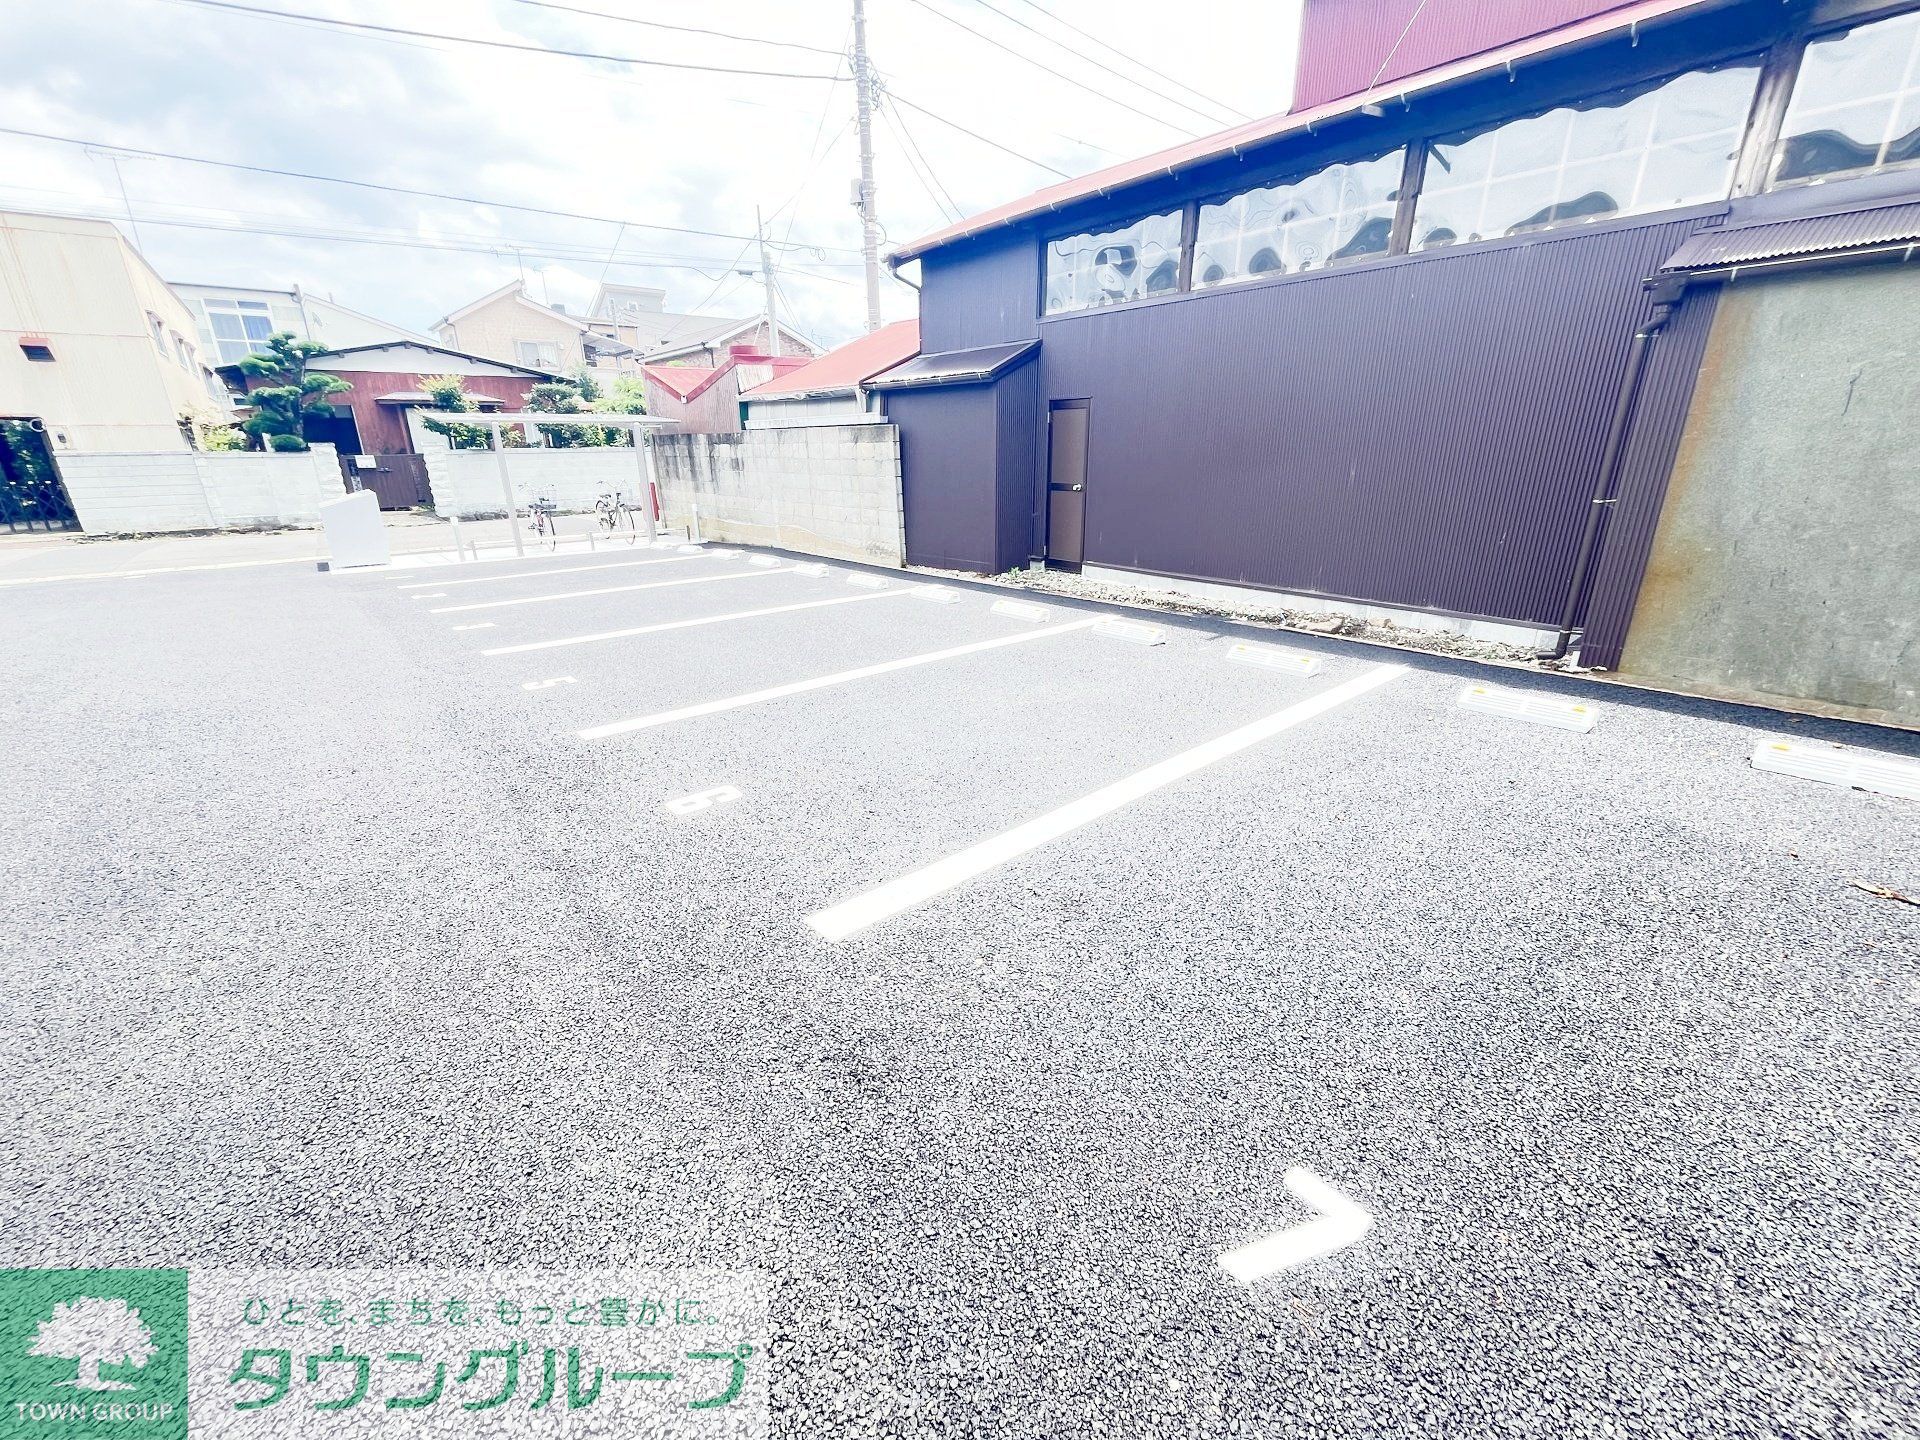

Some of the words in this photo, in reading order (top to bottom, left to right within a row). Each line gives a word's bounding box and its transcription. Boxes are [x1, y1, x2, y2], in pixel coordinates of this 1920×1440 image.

[521, 675, 577, 690] 5
[665, 784, 743, 815] 6
[1217, 1166, 1374, 1284] 7
